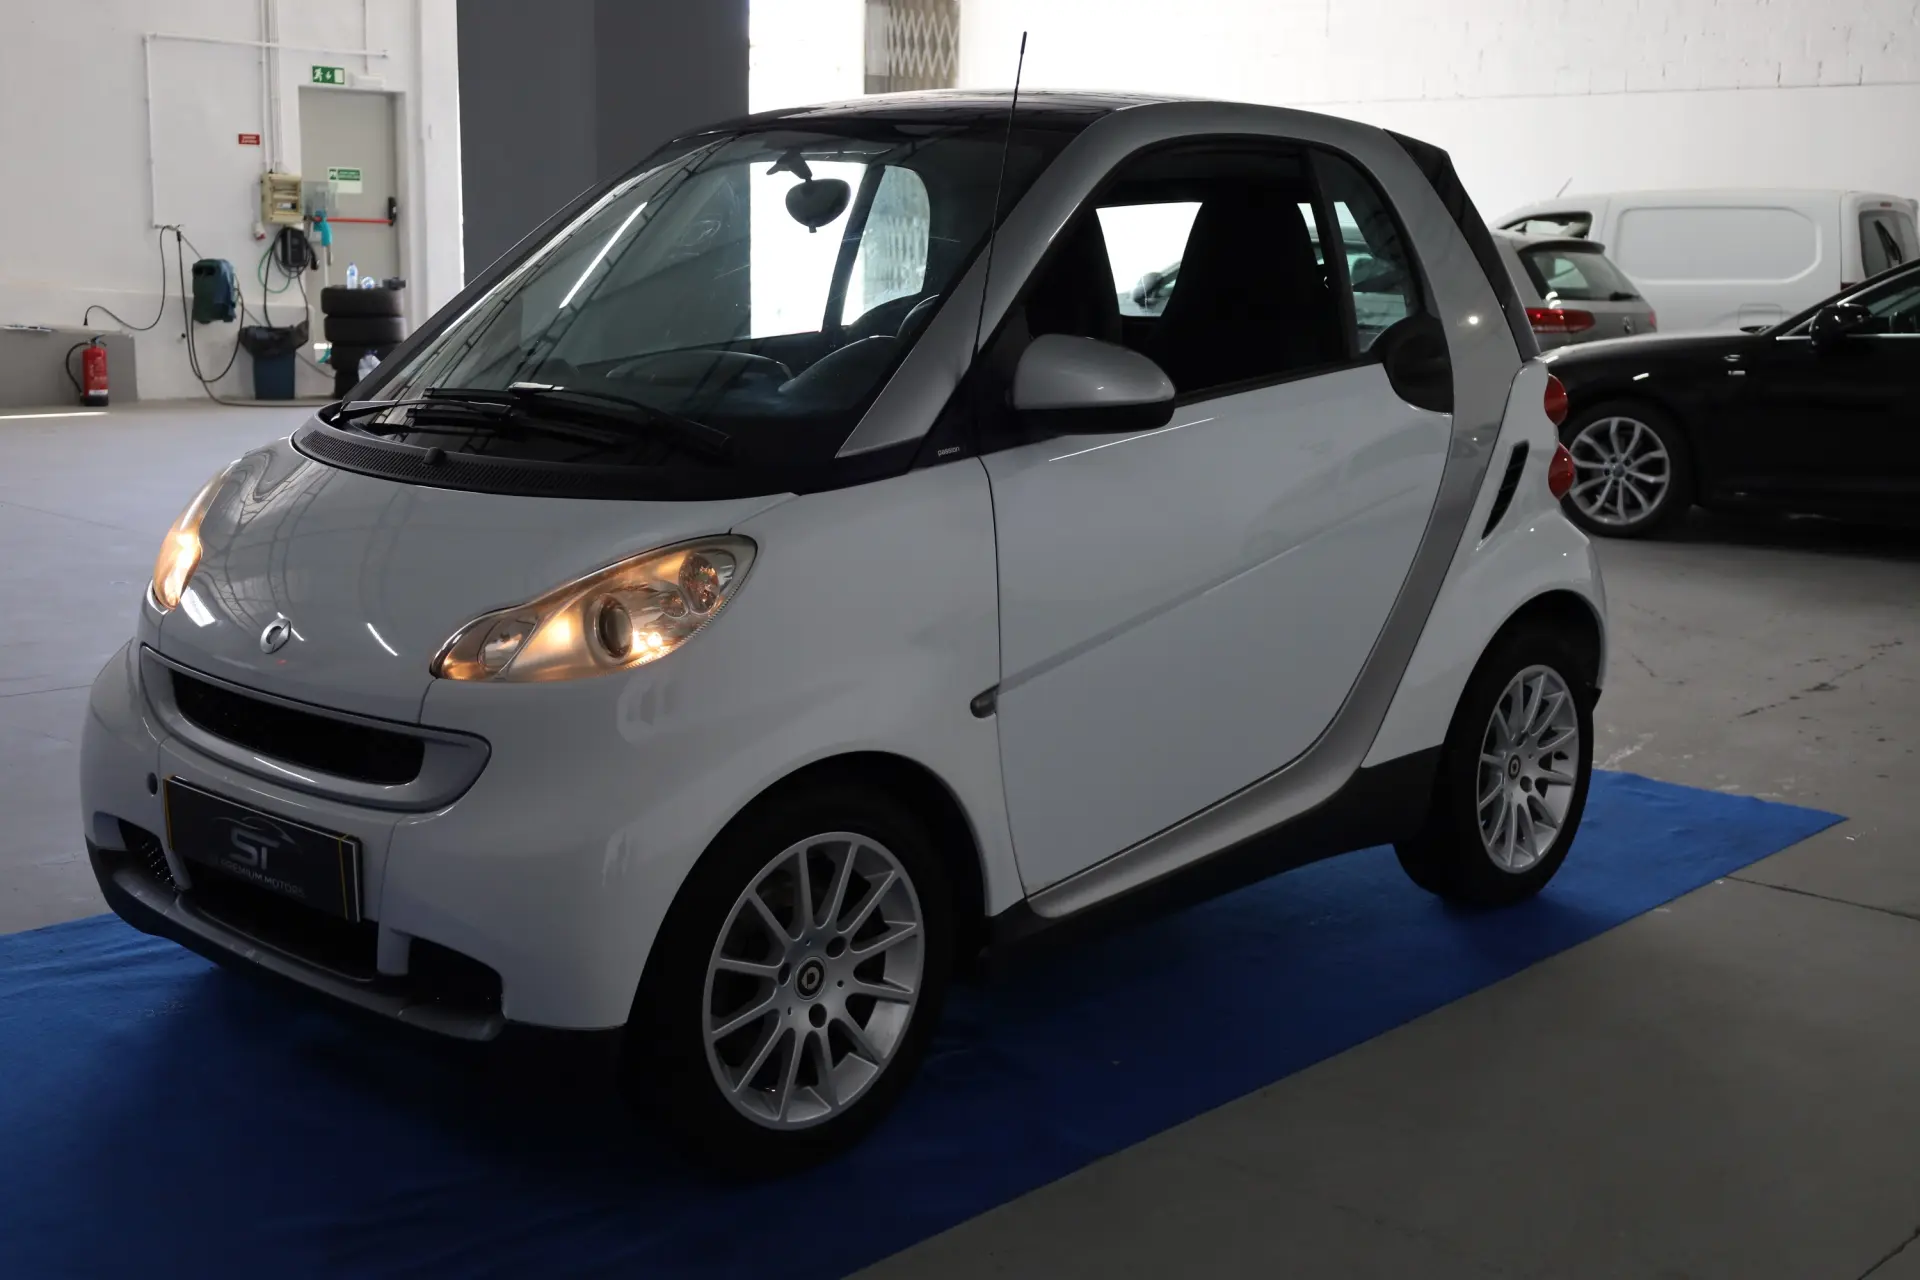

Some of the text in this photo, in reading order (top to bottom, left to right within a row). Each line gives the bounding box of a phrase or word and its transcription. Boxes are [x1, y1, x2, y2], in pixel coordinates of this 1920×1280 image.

[937, 446, 960, 457] passion
[229, 827, 280, 870] ST
[264, 876, 306, 897] MOTORS
